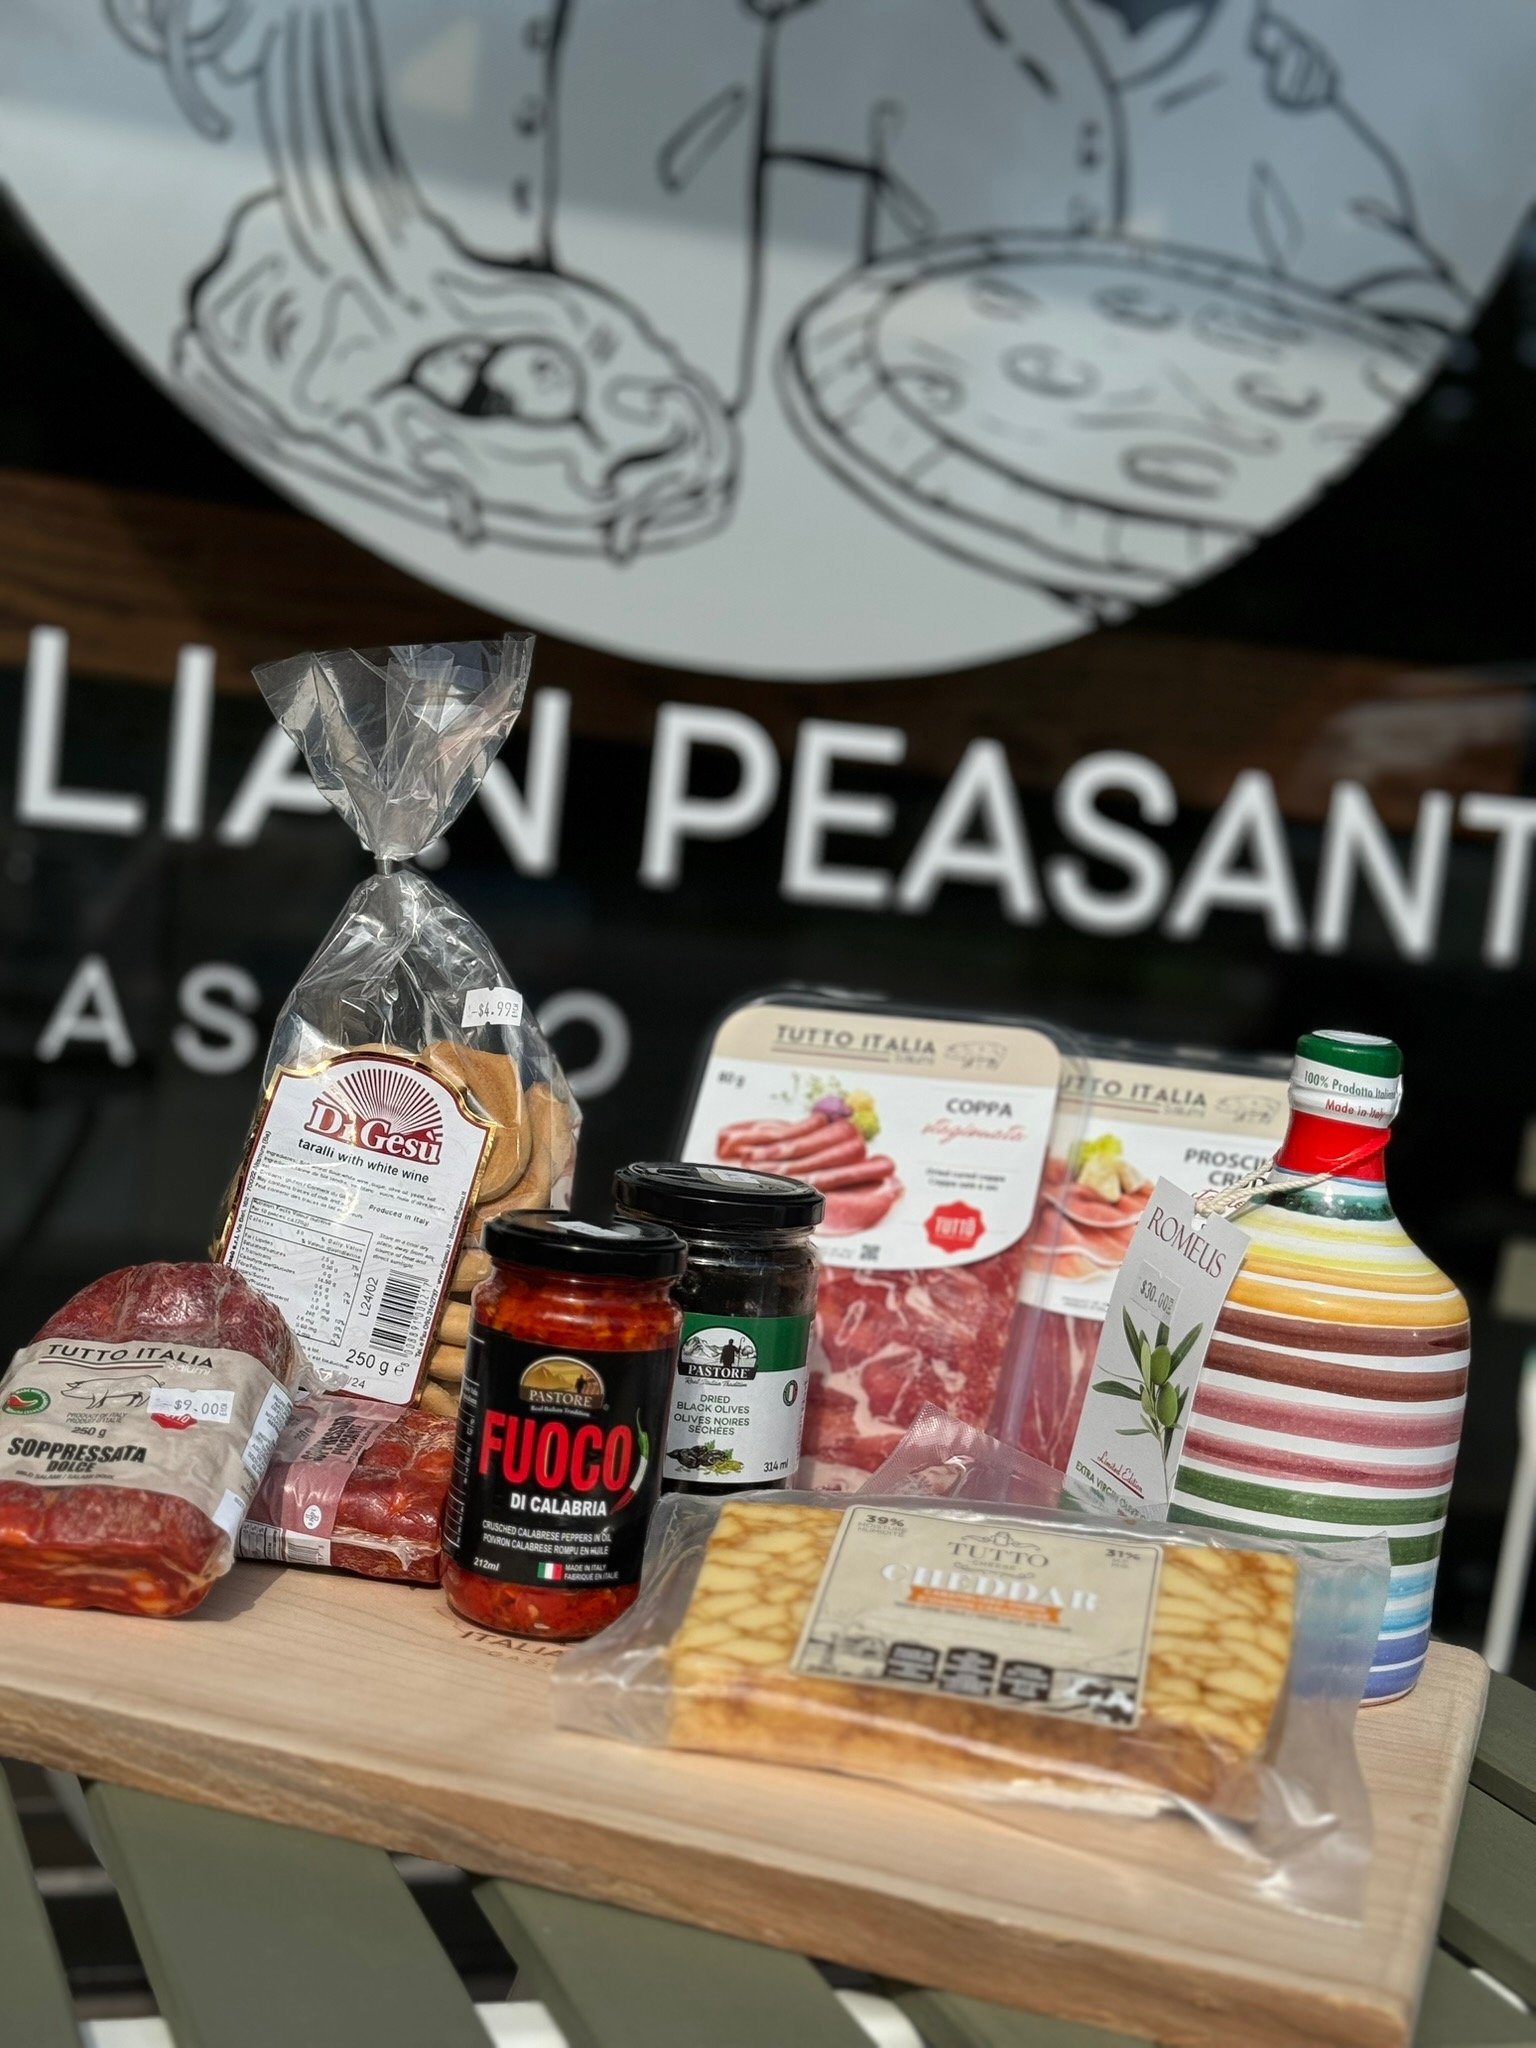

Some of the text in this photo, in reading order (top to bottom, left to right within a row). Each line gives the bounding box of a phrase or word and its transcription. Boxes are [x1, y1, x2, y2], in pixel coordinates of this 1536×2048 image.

[637, 702, 1536, 968] PEASANT
[776, 1024, 936, 1054] TUTTO ITALIA
[1130, 1082, 1206, 1108] ITALIA
[1305, 1070, 1329, 1088] 100%
[1332, 1078, 1373, 1097] Prodotto
[946, 1098, 1013, 1118] COPPA
[1325, 1099, 1354, 1114] Made
[1357, 1106, 1367, 1117] in
[297, 1137, 430, 1184] taralli with white wine
[245, 1170, 257, 1192] 70022
[367, 1203, 402, 1219] Produced
[404, 1213, 411, 1221] in
[412, 1215, 430, 1227] Italy
[1147, 1205, 1227, 1279] ROMEUS
[358, 1276, 379, 1318] L24/02
[1140, 1280, 1169, 1311] $30.00
[48, 1344, 214, 1368] TUTTO ITALIA
[345, 1348, 376, 1369] 250
[378, 1360, 390, 1376] g
[688, 1365, 748, 1378] PASTORE
[529, 1389, 593, 1408] PASTORE
[677, 1402, 750, 1414] BLACK OLIVES
[700, 1394, 730, 1403] DRIED
[673, 1414, 750, 1426] OLIVES NOIRES
[71, 1426, 108, 1439] 250 g
[331, 1423, 366, 1456] PICCANTE
[7, 1437, 147, 1463] SOPPRESSATA
[478, 1408, 633, 1491] FUOCO
[46, 1460, 97, 1473] DOLCE
[764, 1458, 789, 1472] 314 ml
[1098, 1451, 1143, 1493] Limited Edition
[1076, 1460, 1095, 1483] EXTRA
[1096, 1478, 1119, 1501] VIRGIN
[510, 1492, 607, 1517] DI CALABRIA
[482, 1520, 612, 1542] CRUSCHED CALABRESE PEPPERS IN OIL
[866, 1514, 905, 1527] 39%
[482, 1533, 609, 1555] POIVRON CALABRESE ROMPU EN HUILE
[947, 1540, 1050, 1569] TUTTO
[1105, 1549, 1141, 1561] 31%
[473, 1557, 500, 1572] 212ml
[564, 1572, 593, 1580] FABRIQUE
[594, 1572, 602, 1580] EN
[565, 1564, 584, 1572] MADE
[881, 1563, 1099, 1612] CHEDDAR
